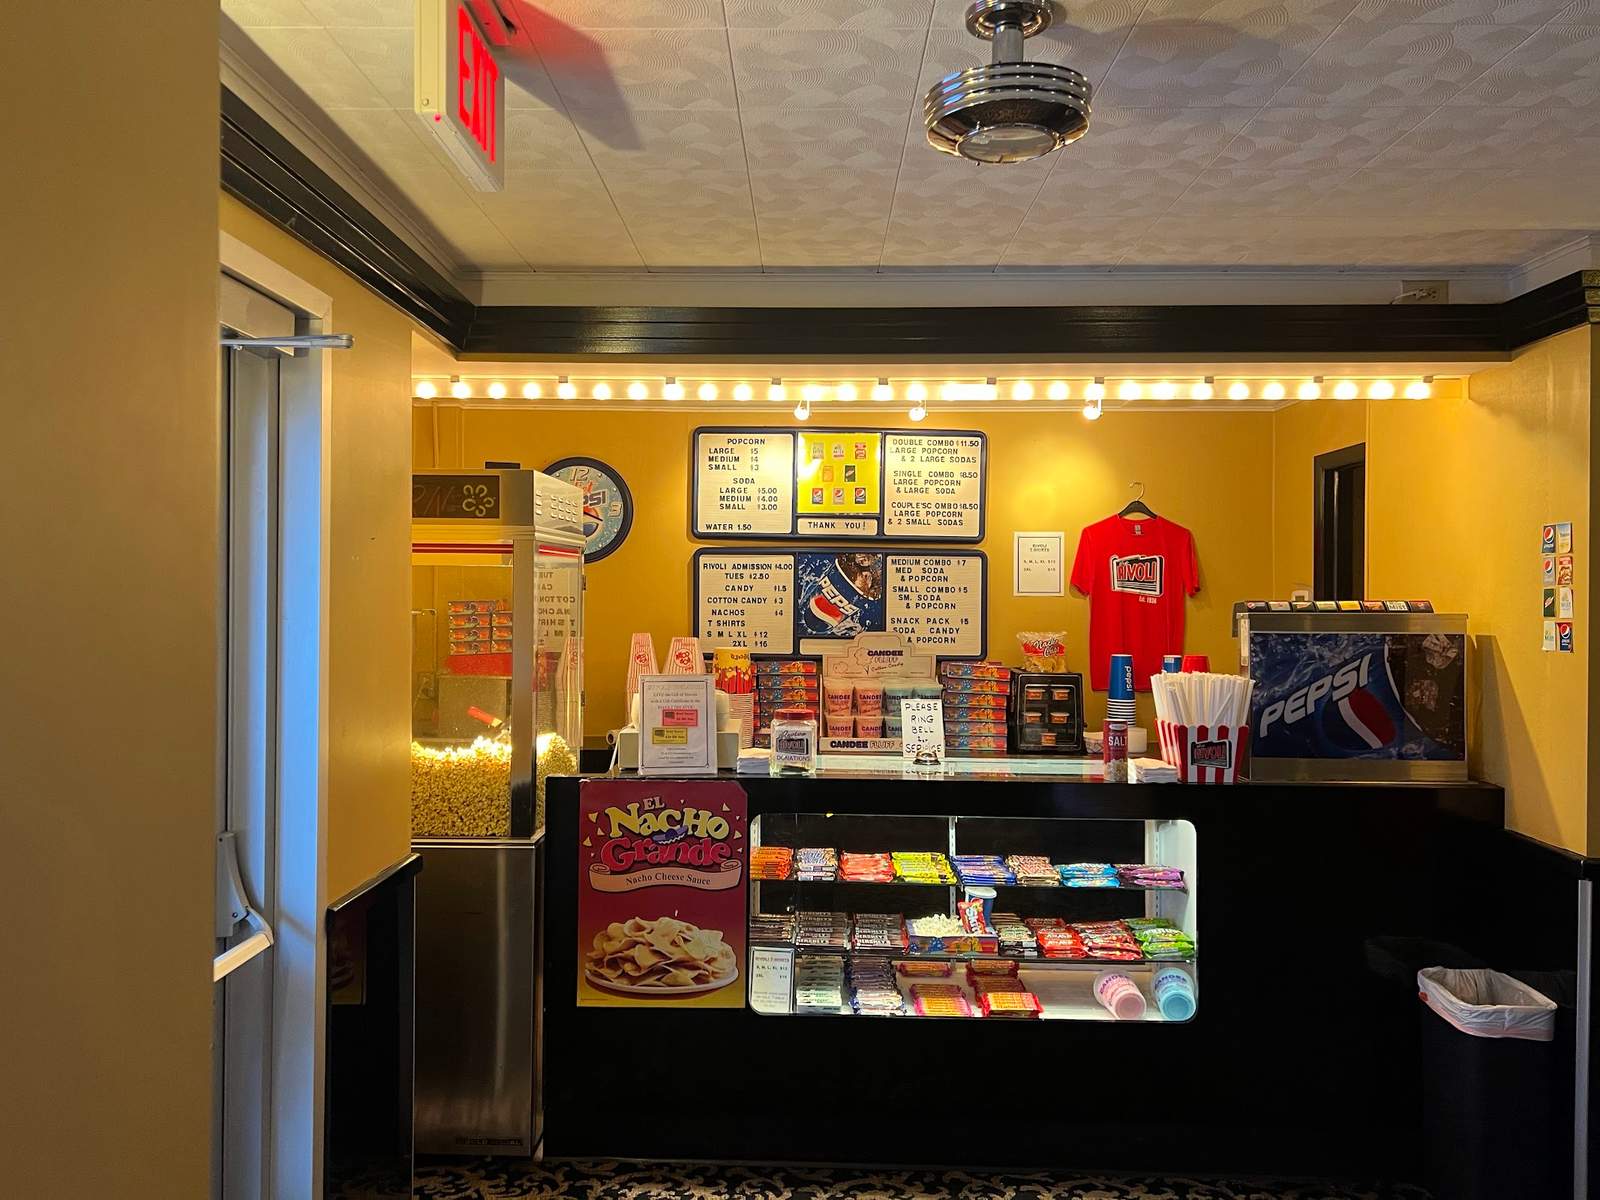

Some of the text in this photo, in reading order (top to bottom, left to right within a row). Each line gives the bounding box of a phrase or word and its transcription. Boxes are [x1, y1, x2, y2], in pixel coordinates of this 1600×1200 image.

[457, 4, 499, 165] EXIT
[570, 468, 589, 482] 12
[608, 502, 623, 518] 3
[808, 521, 866, 530] THANK YOU!
[1117, 560, 1158, 582] RIVOLI
[1260, 653, 1372, 738] PEPSI
[905, 703, 938, 711] PLEASE
[870, 741, 895, 749] FLUFF
[1108, 736, 1127, 747] SALT
[642, 796, 665, 811] EL
[601, 837, 732, 872] Grande
[626, 873, 711, 886] Nacho Cheese Sauce
